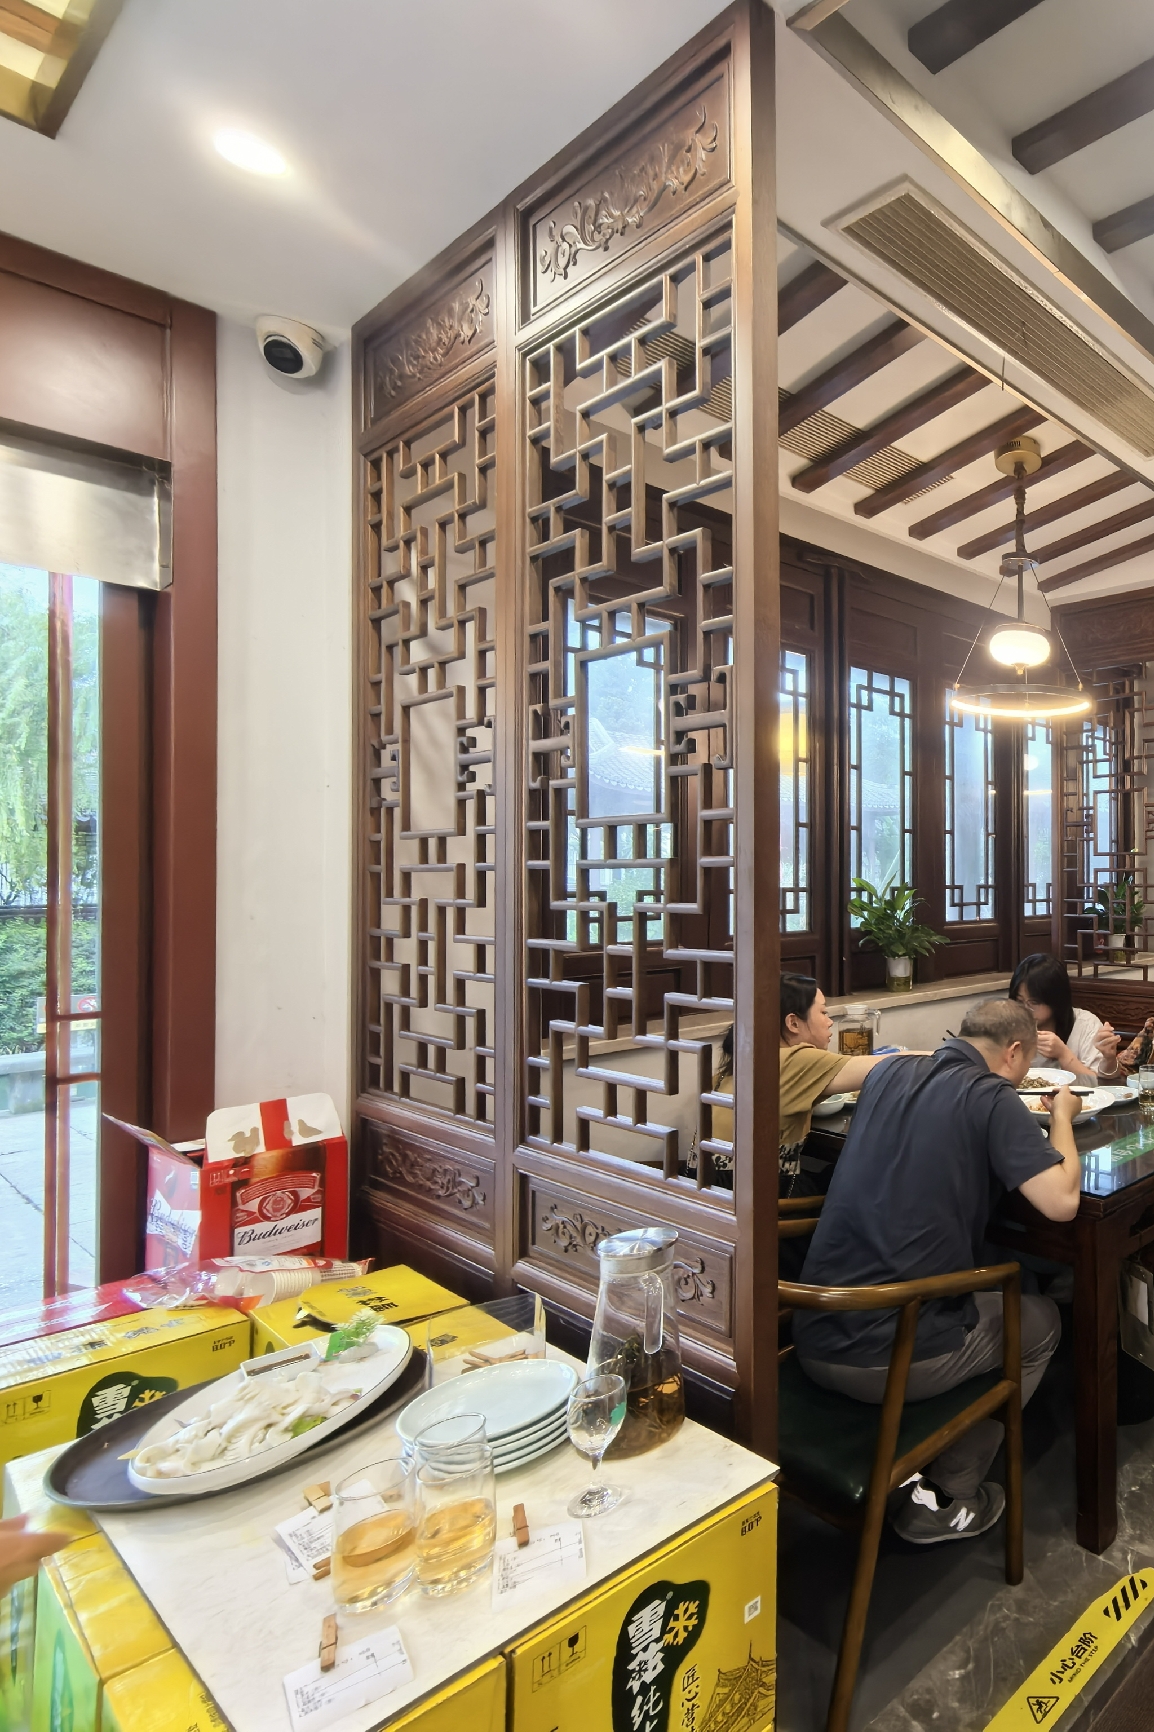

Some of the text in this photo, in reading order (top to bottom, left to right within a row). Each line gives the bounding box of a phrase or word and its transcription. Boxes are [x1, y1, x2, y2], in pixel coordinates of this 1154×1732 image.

[237, 1217, 319, 1245] Budweiser
[1049, 1631, 1098, 1685] 小心台阶
[1067, 1667, 1082, 1683] MIND
[1080, 1657, 1091, 1667] THE
[682, 1663, 700, 1732] 匠心营
